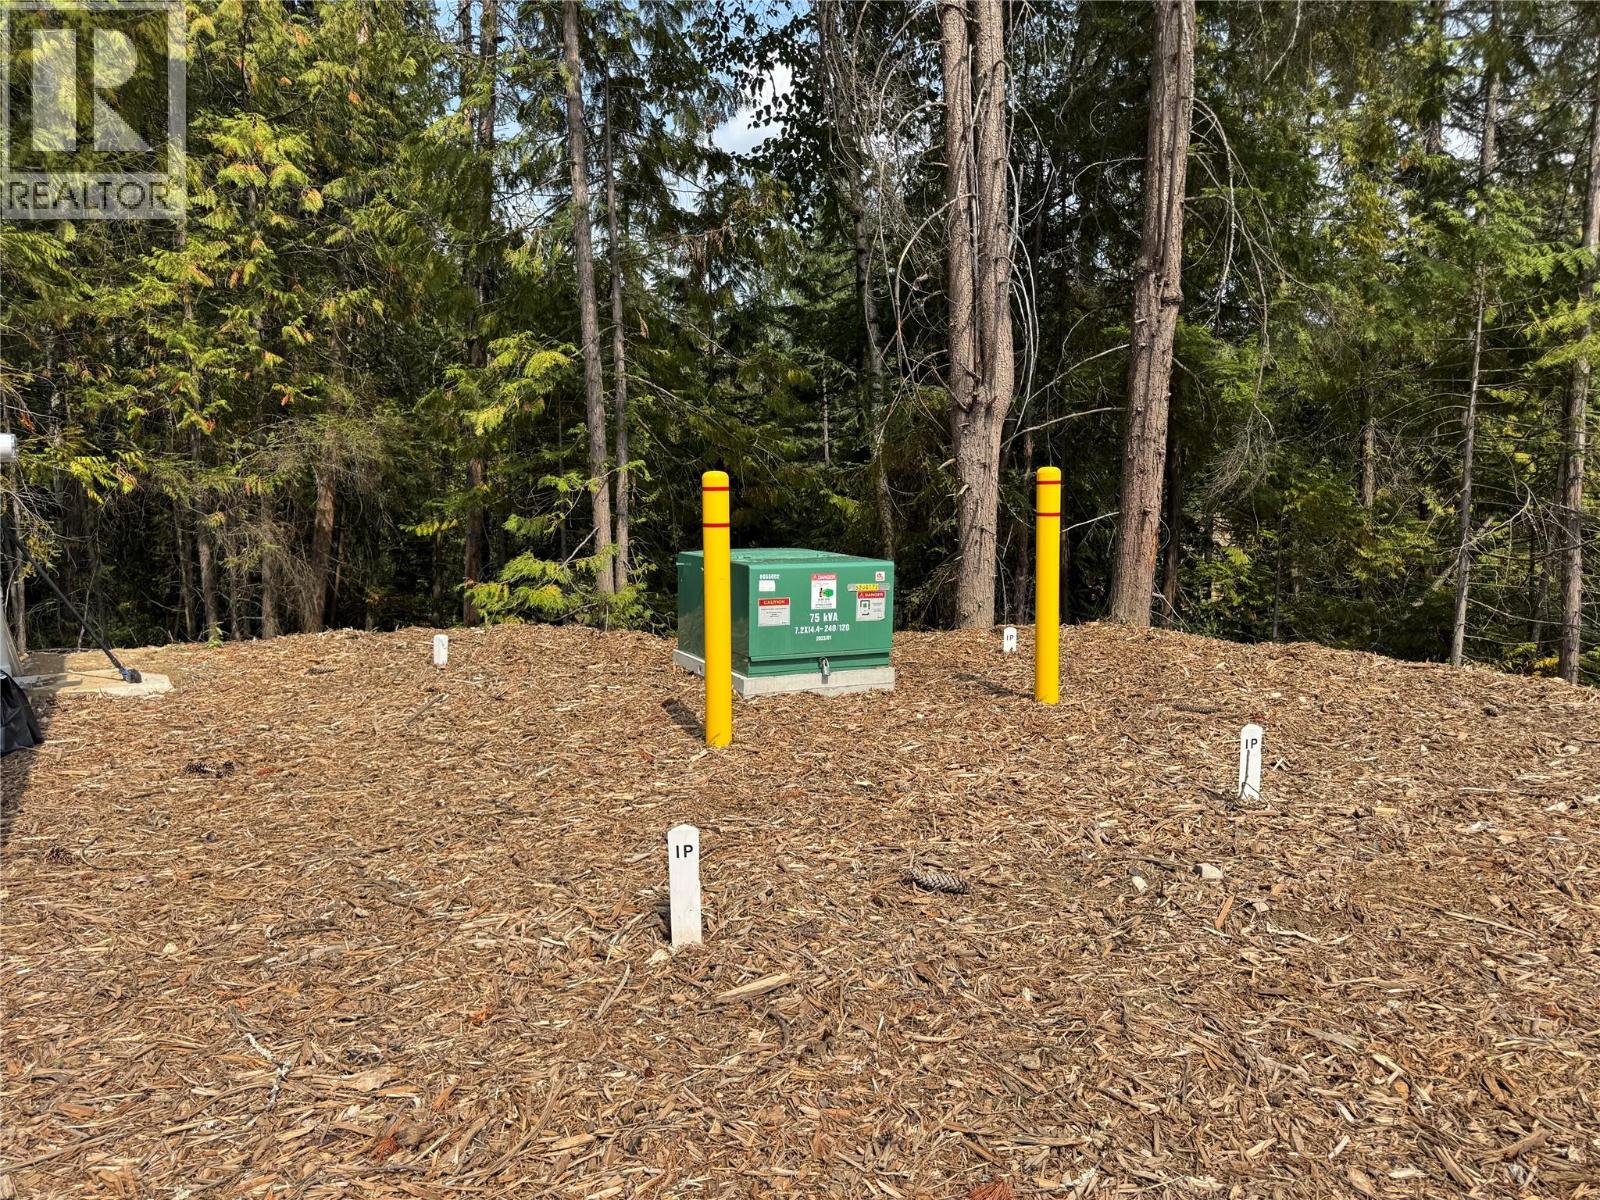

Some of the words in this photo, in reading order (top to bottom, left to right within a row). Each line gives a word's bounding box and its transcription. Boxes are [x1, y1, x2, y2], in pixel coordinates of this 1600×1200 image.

[809, 613, 820, 623] 75
[823, 612, 839, 622] kVA
[1006, 634, 1015, 642] IP
[1245, 738, 1258, 750] IP
[675, 844, 694, 859] IP
